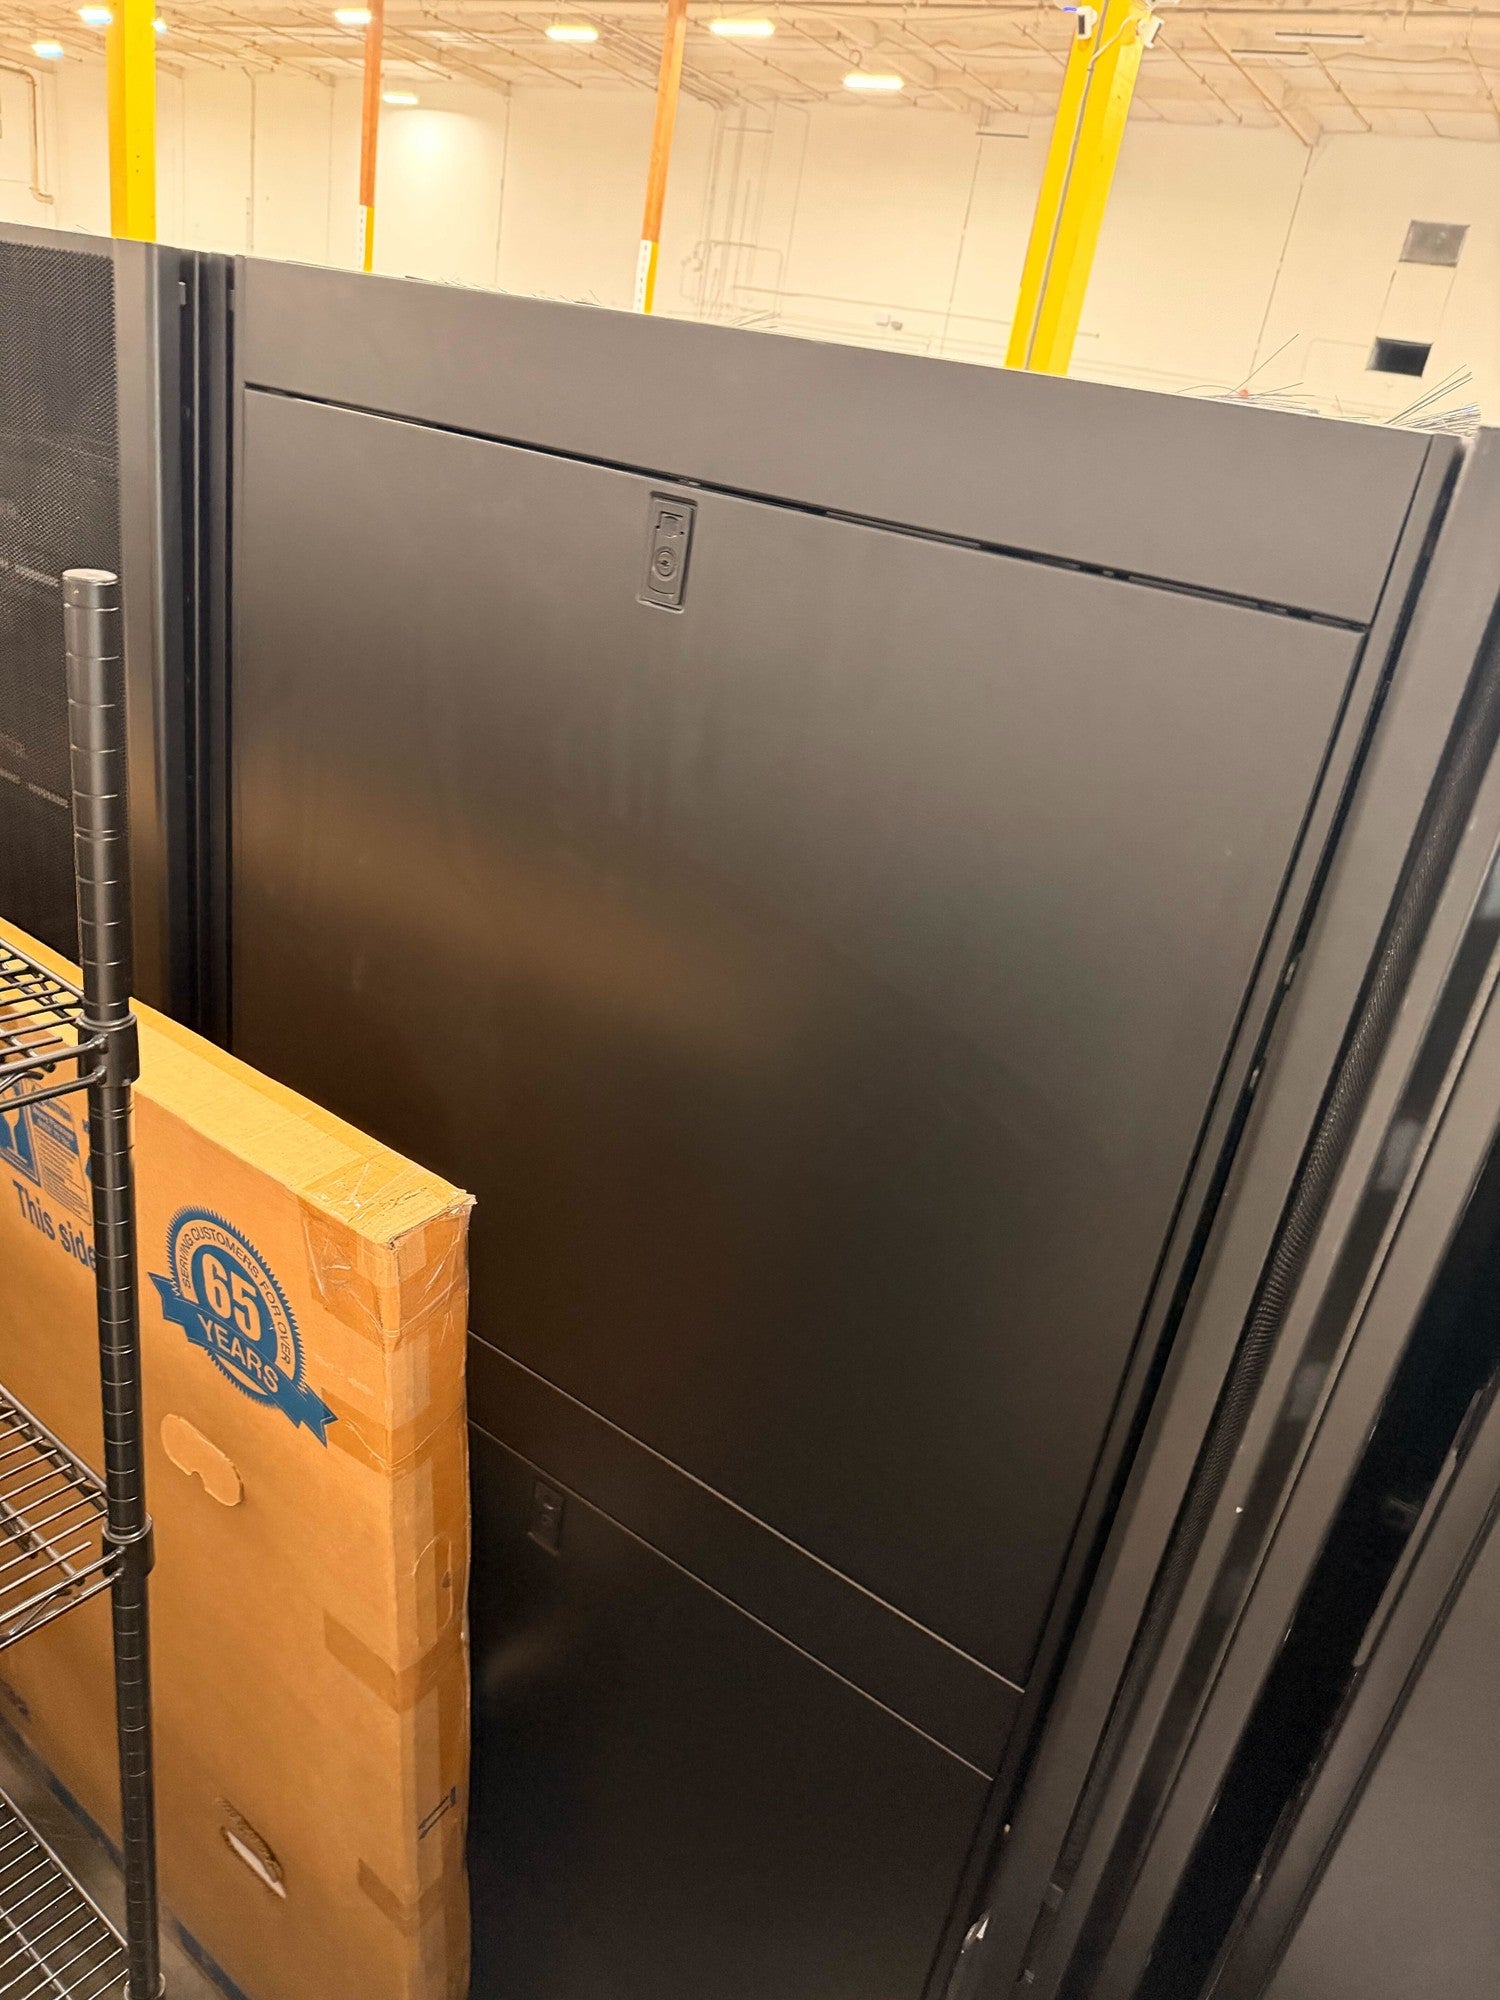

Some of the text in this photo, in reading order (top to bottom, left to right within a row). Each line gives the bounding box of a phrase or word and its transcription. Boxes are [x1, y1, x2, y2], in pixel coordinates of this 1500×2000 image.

[13, 1179, 55, 1240] This
[181, 1226, 291, 1365] SERVING CUSTOMERS FOR OVER
[202, 1253, 262, 1342] 65
[197, 1313, 279, 1393] YEARS
